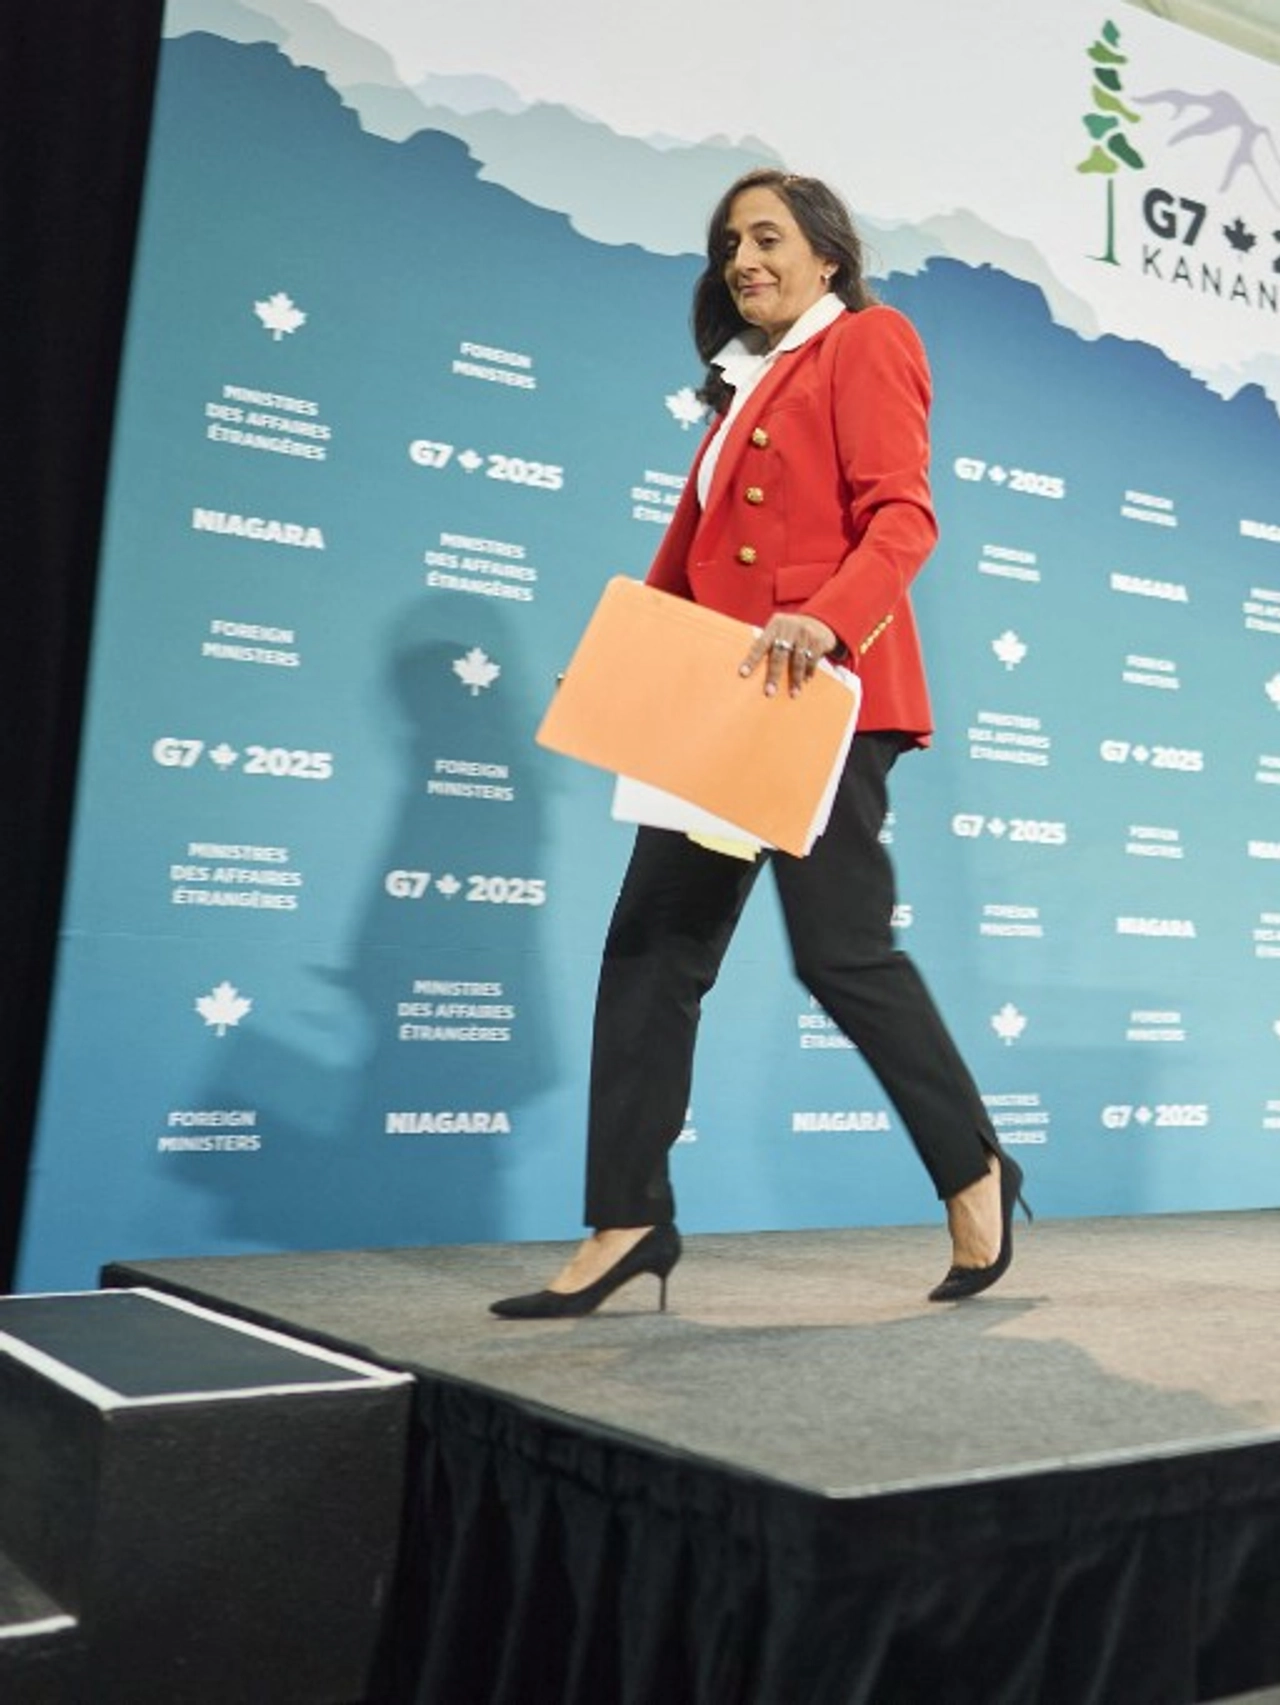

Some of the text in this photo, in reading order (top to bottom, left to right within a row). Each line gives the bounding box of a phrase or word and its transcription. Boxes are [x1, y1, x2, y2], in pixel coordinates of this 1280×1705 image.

[1143, 187, 1208, 246] G7
[460, 342, 532, 369] FOREIGN
[452, 360, 536, 389] MINISTERS
[223, 385, 319, 416] MINISTRES
[205, 402, 331, 441] DES AFFAIRES
[409, 439, 564, 491] G7 2025
[954, 457, 1065, 499] G7 2025
[192, 507, 325, 549] NIAGARA
[424, 551, 460, 569] DES
[211, 620, 294, 644] FOREIGN
[202, 642, 300, 667] MINISTERS
[152, 737, 332, 780] G7 2025
[1099, 739, 1204, 773] G7 2025
[435, 759, 509, 779] FOREIGN
[427, 780, 514, 801] MINISTERS
[951, 813, 1067, 845] G7 2025
[188, 842, 288, 863] MINISTRES
[170, 864, 303, 887] DES AFFAIRES
[385, 869, 546, 906] G7 2025
[172, 887, 298, 910] ÉTRANGÈRES
[1116, 917, 1196, 938] NIAGARA
[413, 980, 503, 997] MINISTRES
[397, 1002, 515, 1020] DES AFFAIRES
[399, 1023, 511, 1042] ÉTRANGÈRES
[168, 1110, 256, 1127] FOREIGN
[385, 1111, 511, 1134] NIAGARA
[792, 1110, 891, 1132] NIAGARA
[1100, 1103, 1209, 1130] G7 2025
[158, 1134, 261, 1152] MINISTERS
